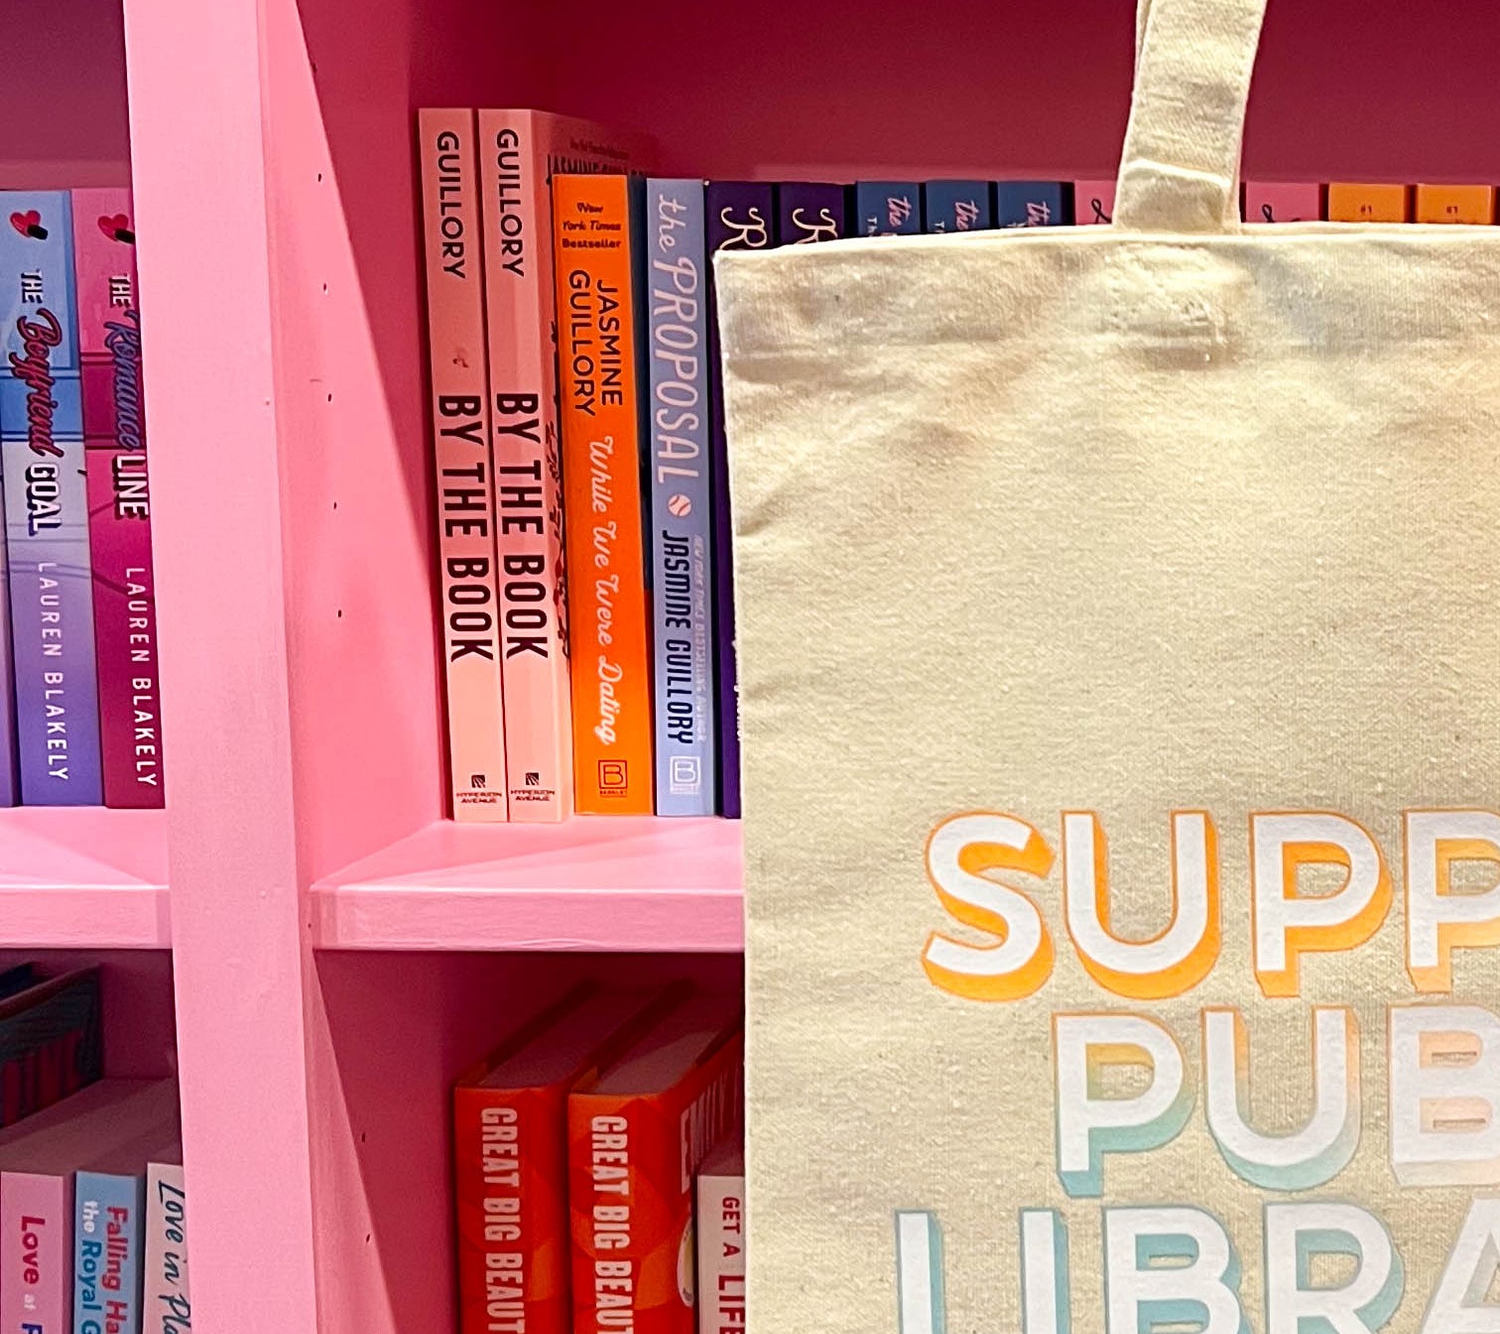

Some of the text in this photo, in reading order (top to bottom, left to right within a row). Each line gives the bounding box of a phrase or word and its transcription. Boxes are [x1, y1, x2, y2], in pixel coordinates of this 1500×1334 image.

[437, 132, 465, 279] GUILLORY
[11, 270, 63, 534] THE Boyfriend GOAL
[569, 270, 595, 416] GUILLORY
[598, 279, 623, 407] JASMINE
[654, 195, 699, 485] the PROPOSAL
[439, 395, 494, 662] BY THE BOOK
[588, 436, 623, 745] While We Were Dating
[39, 563, 68, 781] LAUREN BLAKELY
[663, 530, 694, 745] JASMINE GUILLORY
[82, 1200, 98, 1233] the
[481, 1107, 518, 1189] GREAT
[20, 1215, 46, 1285] Love
[80, 1240, 102, 1311] Royal
[104, 1207, 128, 1293] Falling
[482, 1197, 522, 1241] BIG
[721, 1196, 740, 1257] GET A
